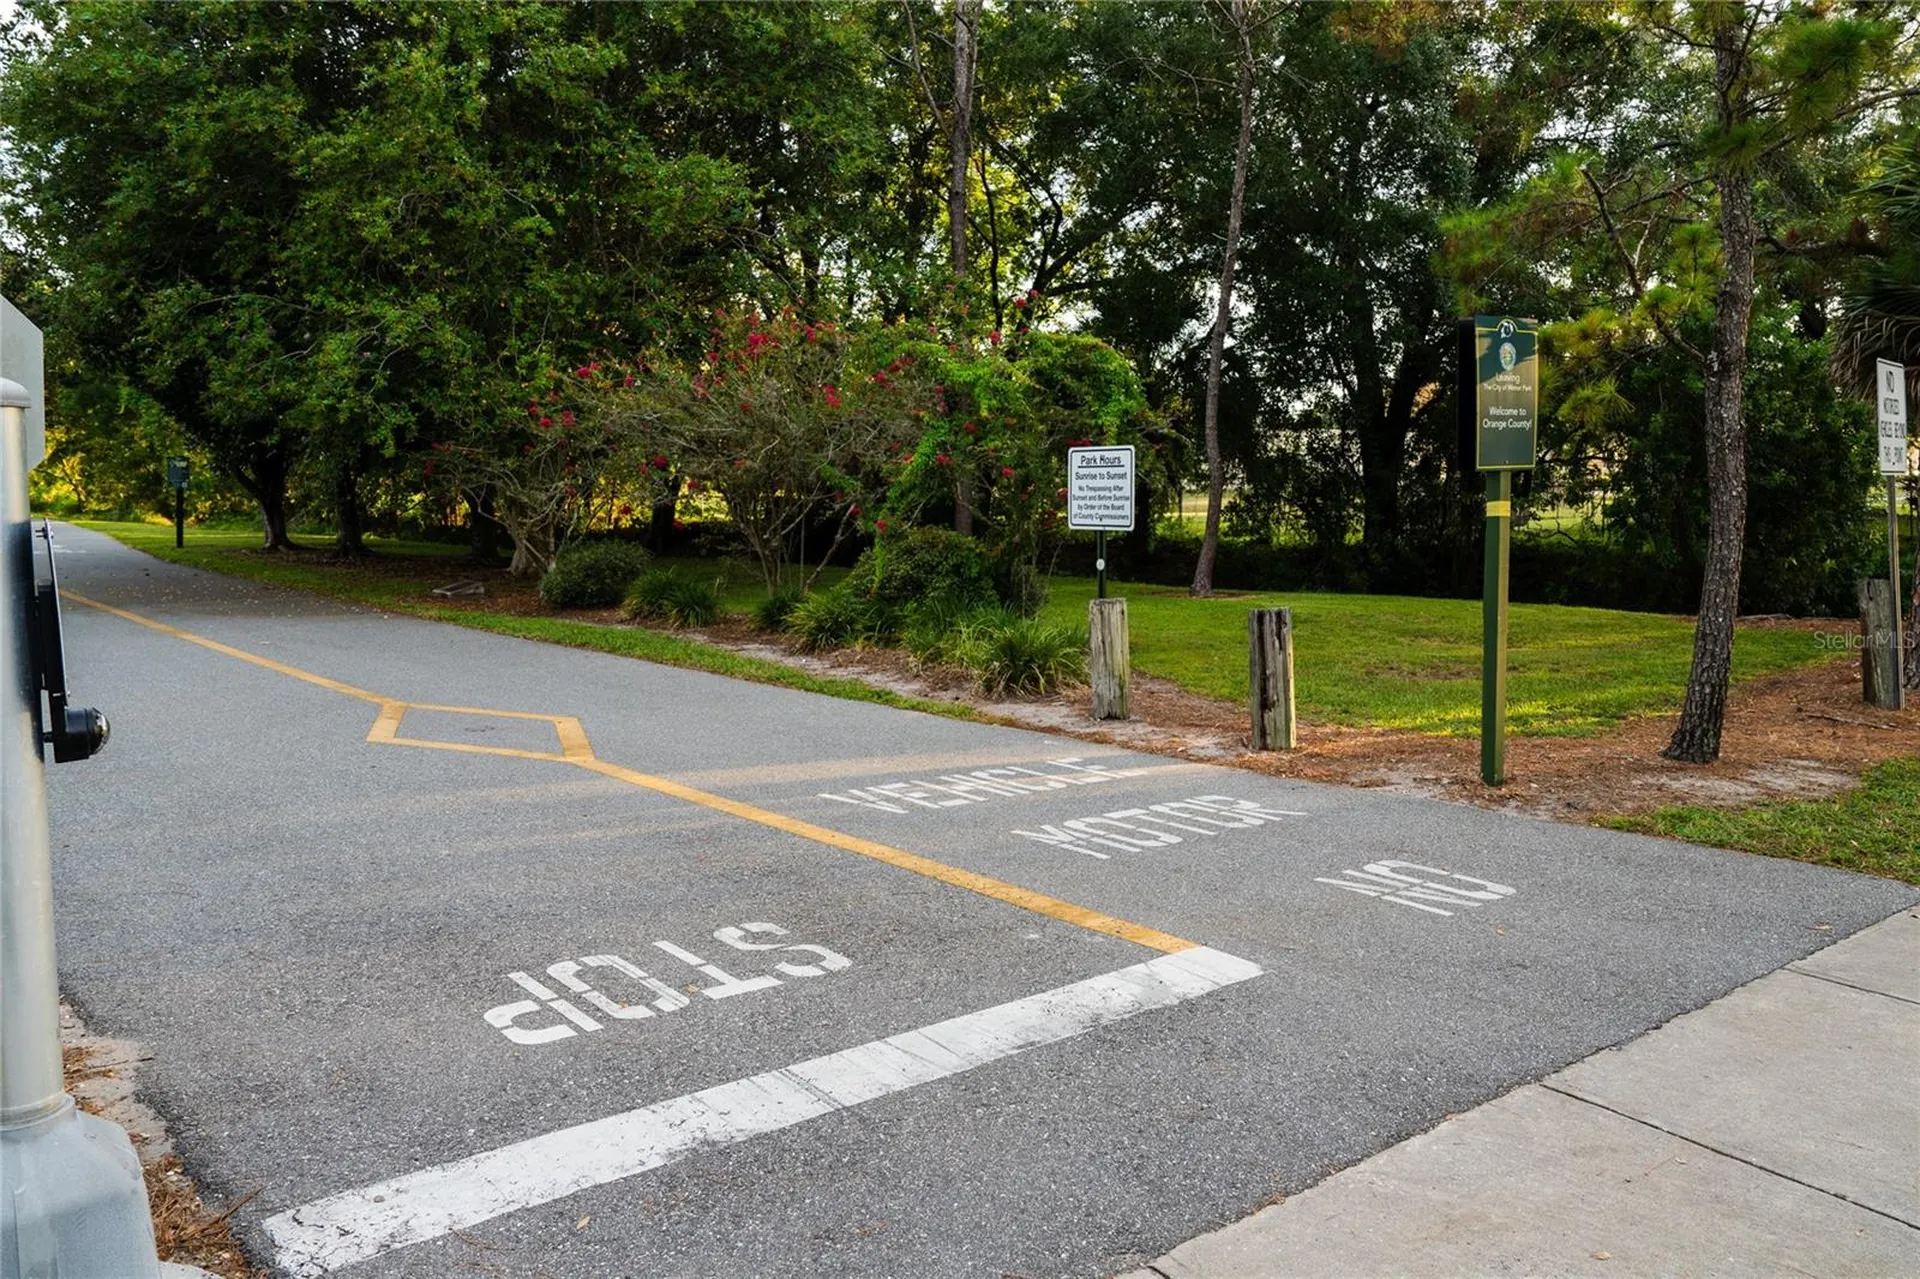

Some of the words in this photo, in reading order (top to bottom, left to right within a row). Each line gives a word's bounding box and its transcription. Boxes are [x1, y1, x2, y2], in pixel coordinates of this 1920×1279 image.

[1496, 373, 1520, 384] Leaving
[1489, 406, 1518, 416] Welcome
[1519, 408, 1526, 416] to
[1482, 418, 1506, 430] Orange
[1508, 418, 1532, 430] County!
[1080, 455, 1098, 464] Park
[1100, 454, 1122, 464] Hours
[1075, 472, 1098, 480] Sunrise
[1106, 471, 1128, 480] Sunset
[817, 757, 1149, 814] VEHICLE
[1011, 795, 1307, 860] MOTOR
[1313, 860, 1517, 917] NO
[483, 922, 853, 1045] STOP
